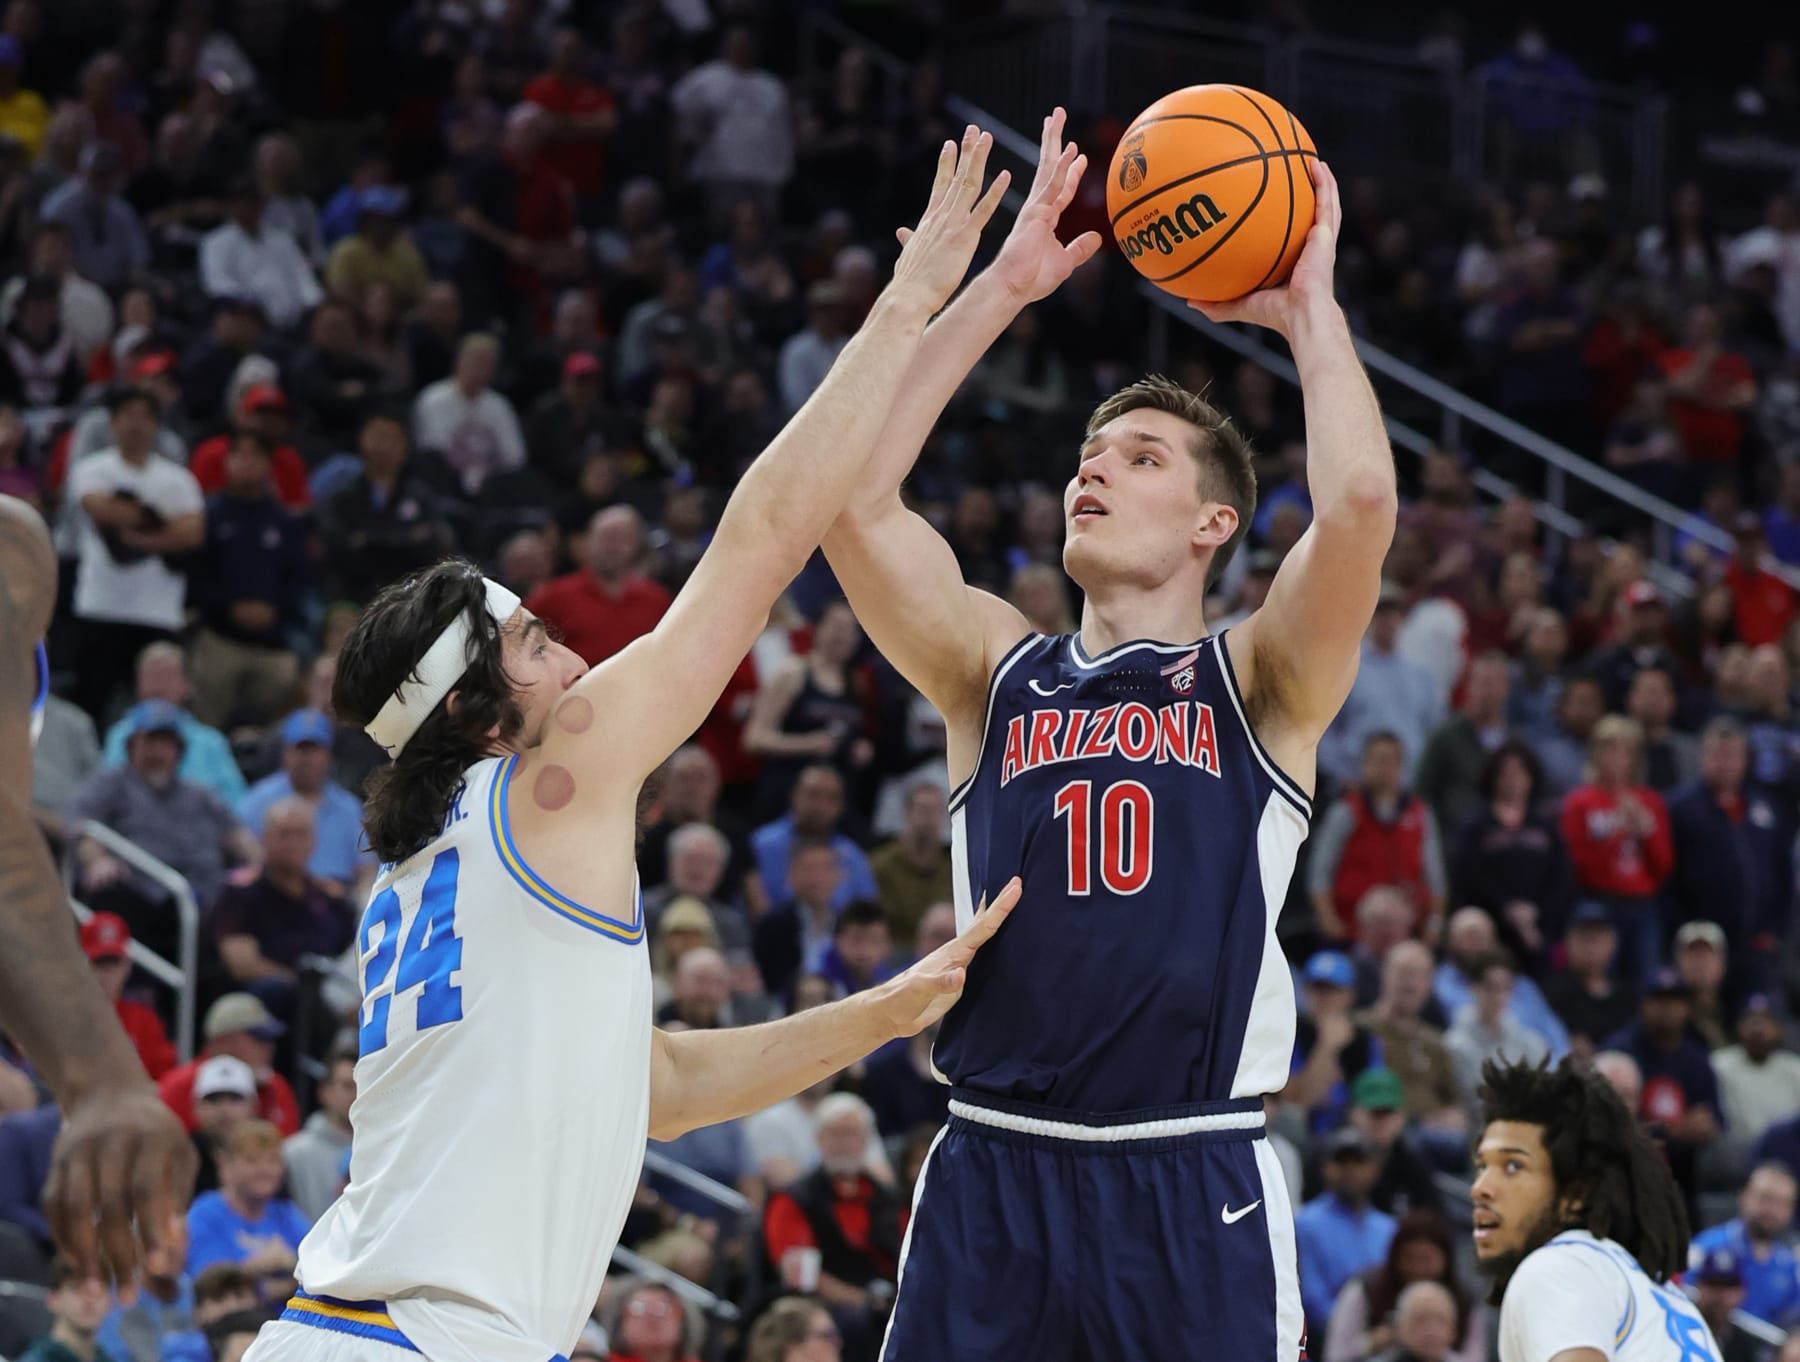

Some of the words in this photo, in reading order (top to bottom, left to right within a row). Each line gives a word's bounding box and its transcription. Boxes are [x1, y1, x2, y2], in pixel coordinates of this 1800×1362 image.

[1119, 194, 1228, 260] Wilson
[1001, 701, 1221, 789] ARIZONA
[1053, 779, 1154, 896] 10
[358, 846, 464, 1059] 24
